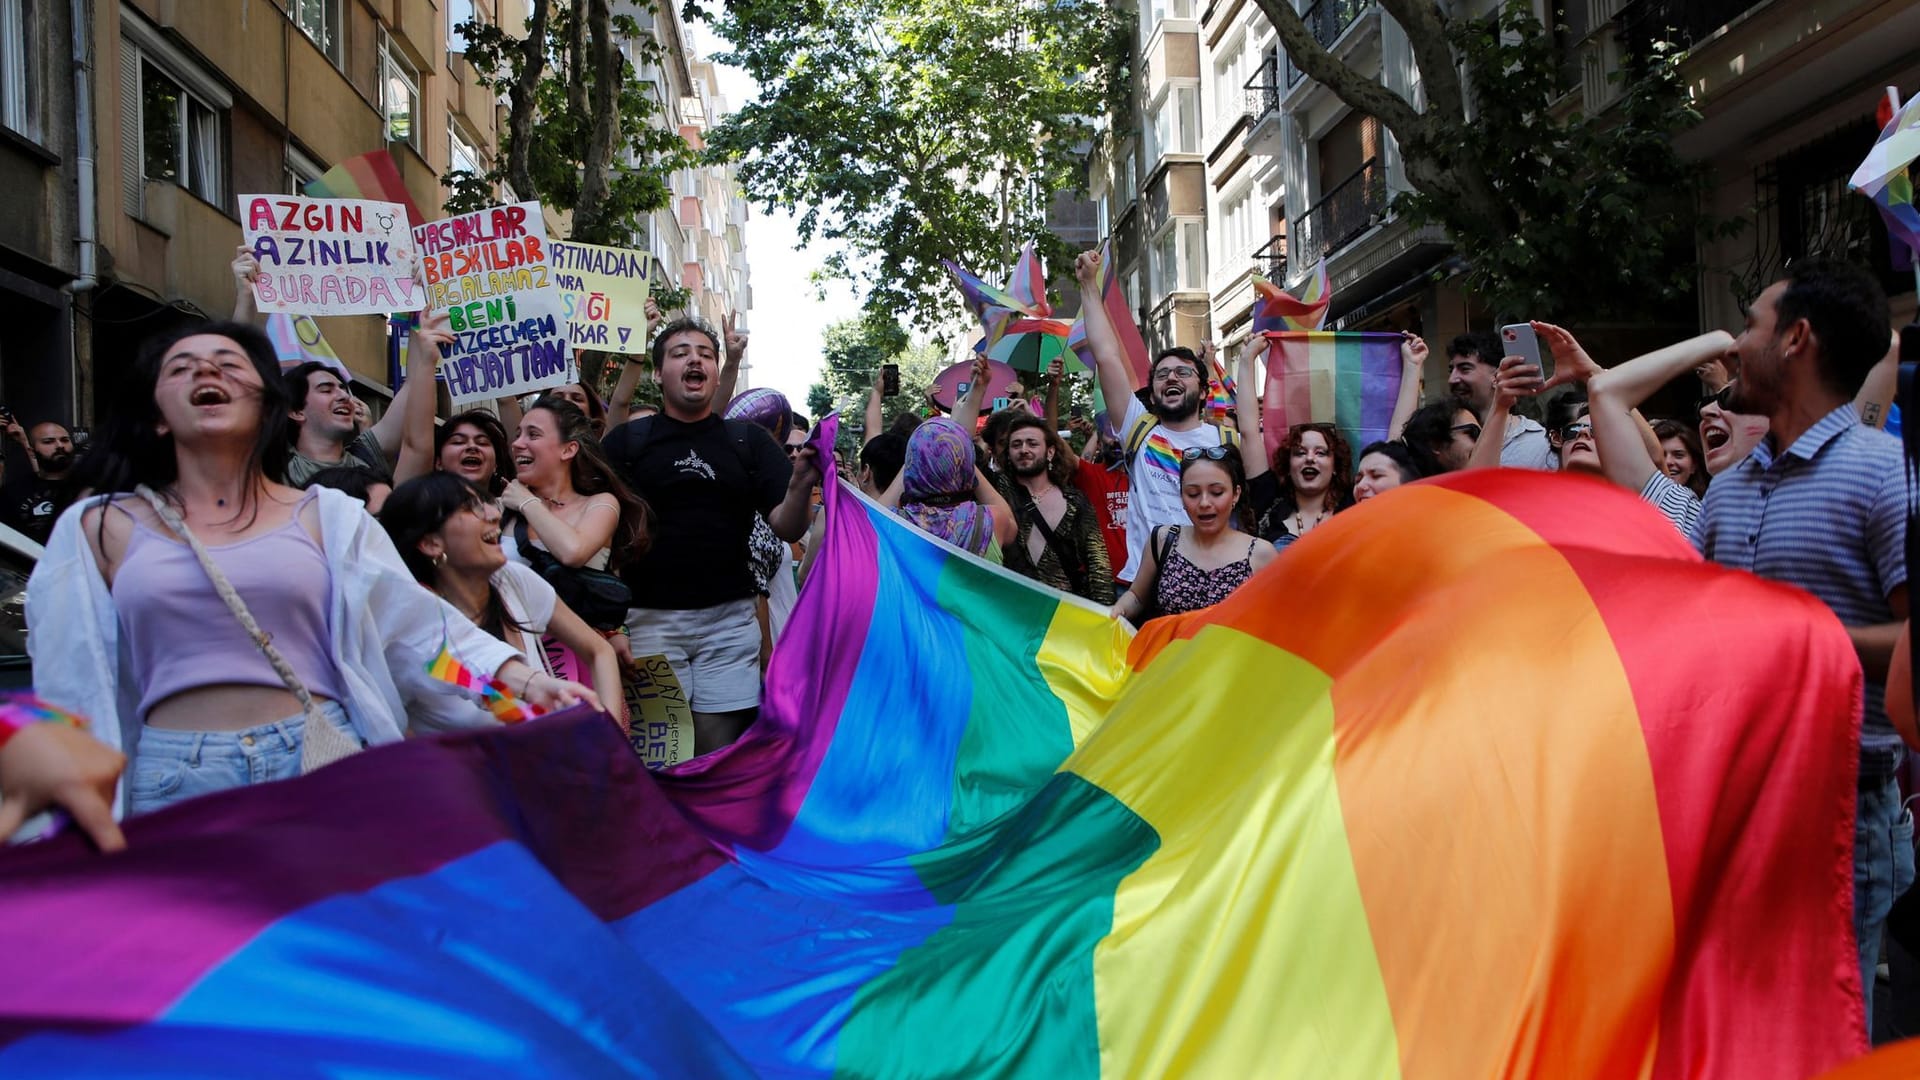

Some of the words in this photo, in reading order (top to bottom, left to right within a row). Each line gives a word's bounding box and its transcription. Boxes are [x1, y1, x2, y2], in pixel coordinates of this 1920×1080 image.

[249, 198, 363, 233] AZGIN
[414, 206, 527, 256] YASAKLAR
[253, 236, 391, 265] AZINLIK
[423, 235, 545, 285] BASKILAR
[449, 295, 517, 332] BENİ
[566, 321, 608, 345] IKAR
[443, 339, 566, 397] HAYATTAN
